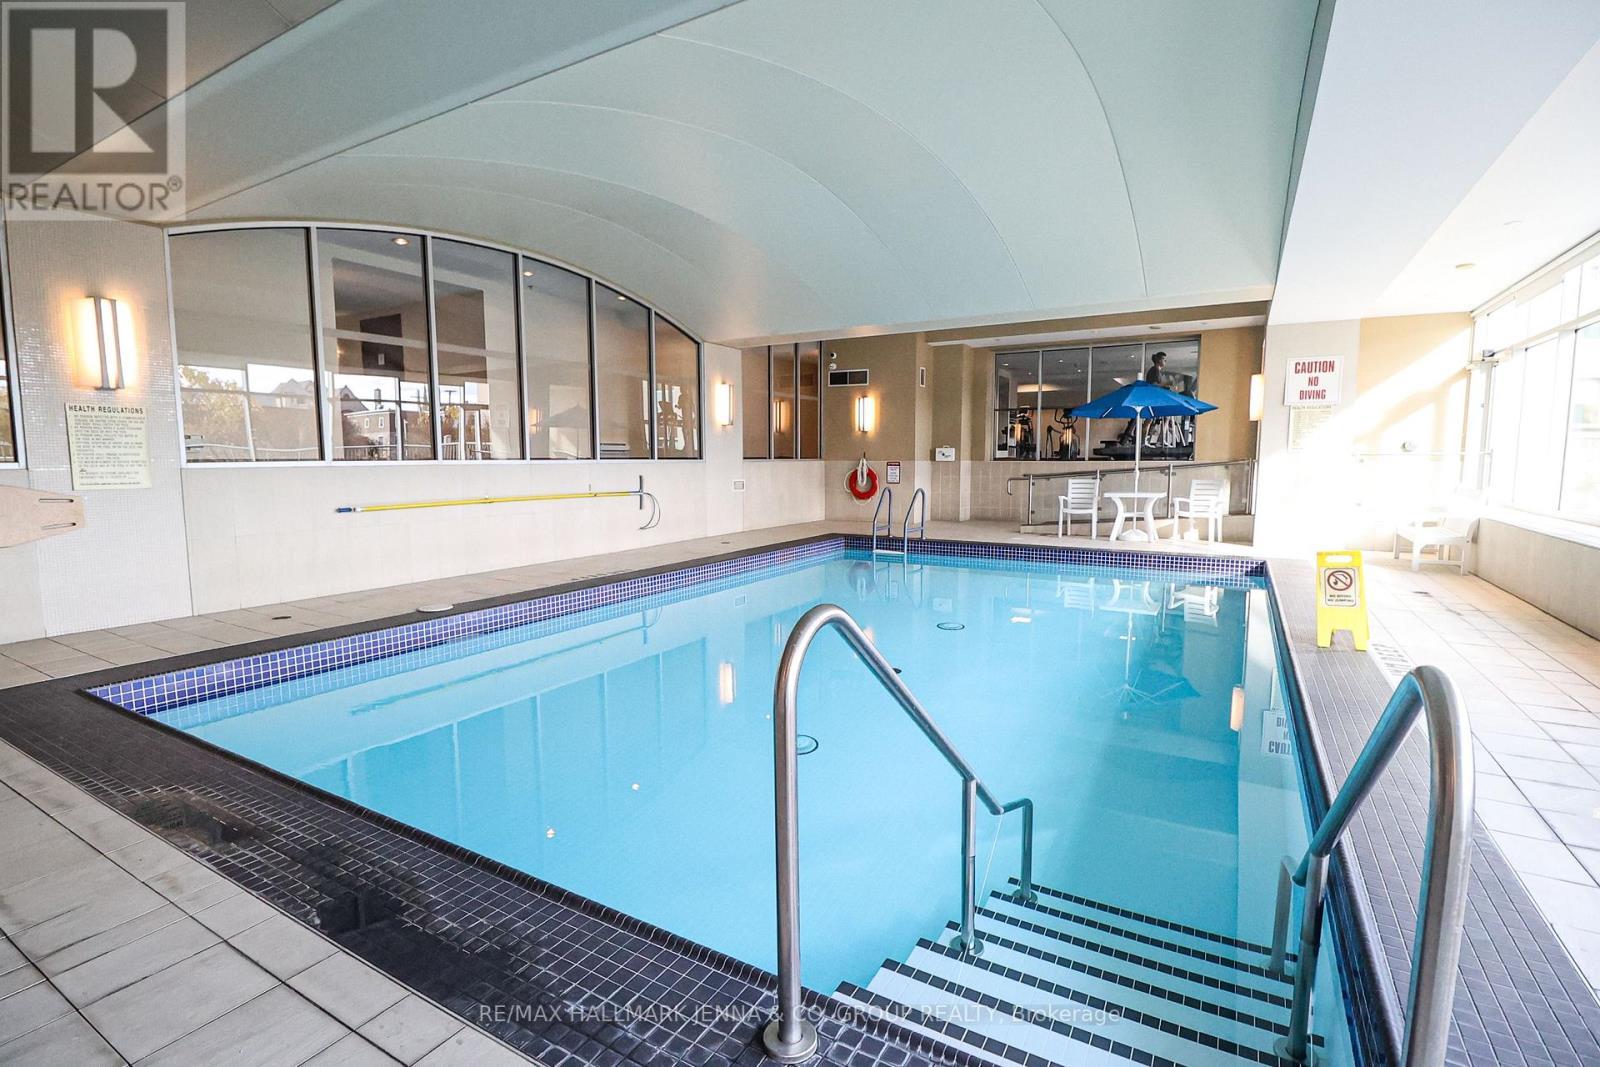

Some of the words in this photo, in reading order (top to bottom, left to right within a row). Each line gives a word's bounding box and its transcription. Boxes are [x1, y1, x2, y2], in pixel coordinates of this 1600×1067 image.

[1295, 360, 1335, 374] CAUTION
[1308, 376, 1319, 386] NO
[1299, 389, 1327, 400] DIVING
[98, 406, 143, 414] REGULATIONS
